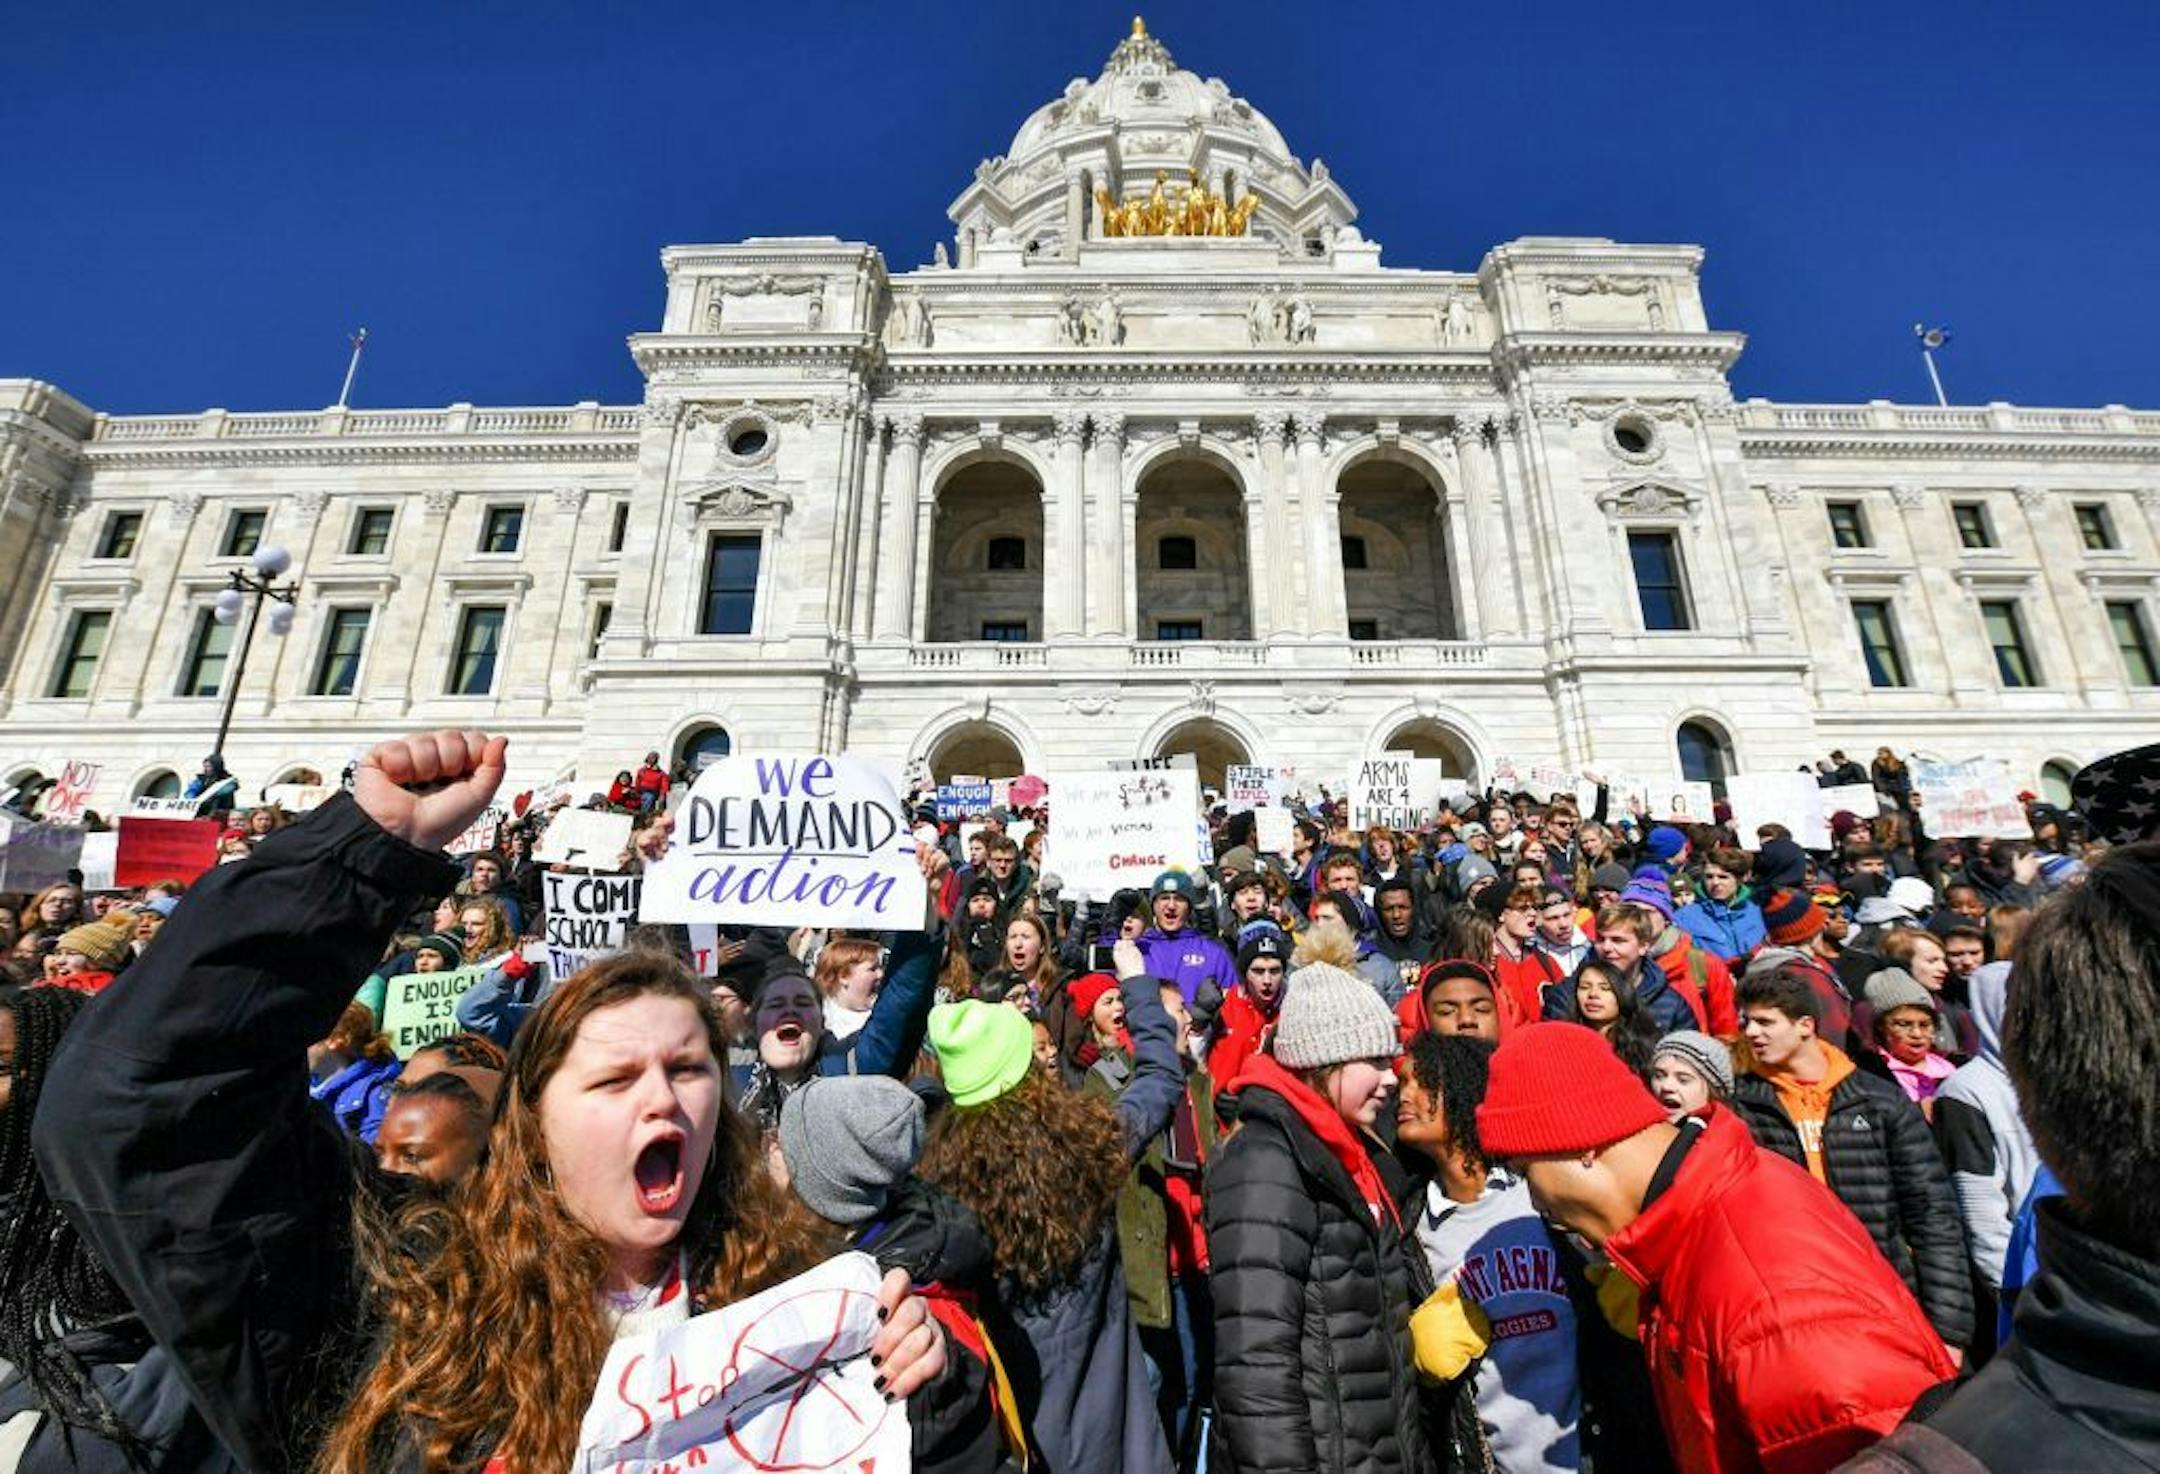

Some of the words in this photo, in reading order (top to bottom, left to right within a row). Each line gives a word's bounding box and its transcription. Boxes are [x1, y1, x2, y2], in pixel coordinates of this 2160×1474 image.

[1358, 760, 1409, 786] ARMS
[49, 786, 92, 815] ONE
[137, 797, 159, 811] NO
[938, 785, 991, 801] ENOUGH
[1366, 788, 1393, 805] ARE
[1400, 788, 1409, 805] 4
[688, 797, 896, 852] DEMAND
[1356, 806, 1429, 829] HUGGING
[449, 826, 494, 851] ATE
[1109, 853, 1166, 869] CHANGE
[689, 846, 896, 912] action
[547, 877, 566, 914] I
[547, 917, 616, 948] SCHOOL
[426, 1000, 453, 1018] IS
